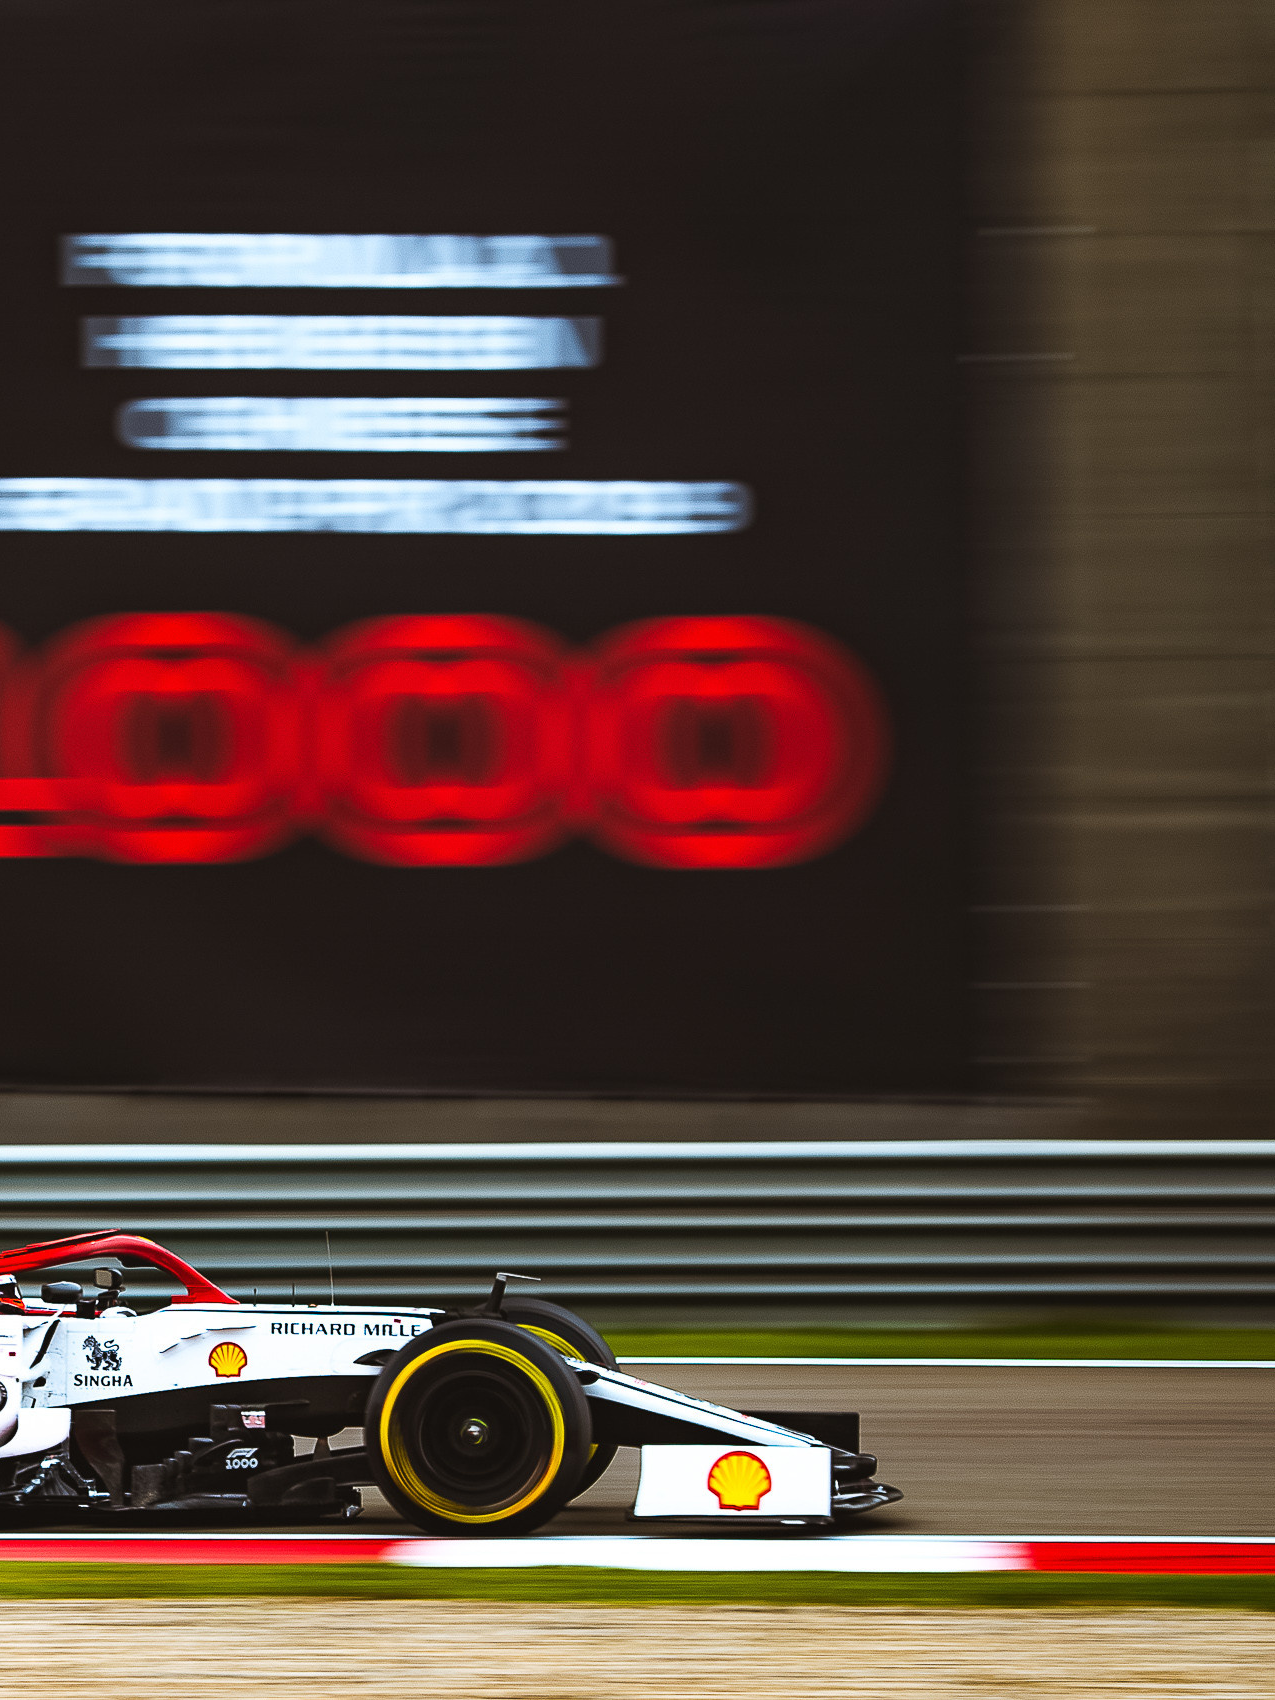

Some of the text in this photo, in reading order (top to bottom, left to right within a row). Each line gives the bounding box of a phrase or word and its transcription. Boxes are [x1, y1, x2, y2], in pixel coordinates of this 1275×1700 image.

[271, 1322, 421, 1337] RICHARD MILLE
[73, 1373, 134, 1387] SINGHA
[225, 1457, 258, 1470] 1000
